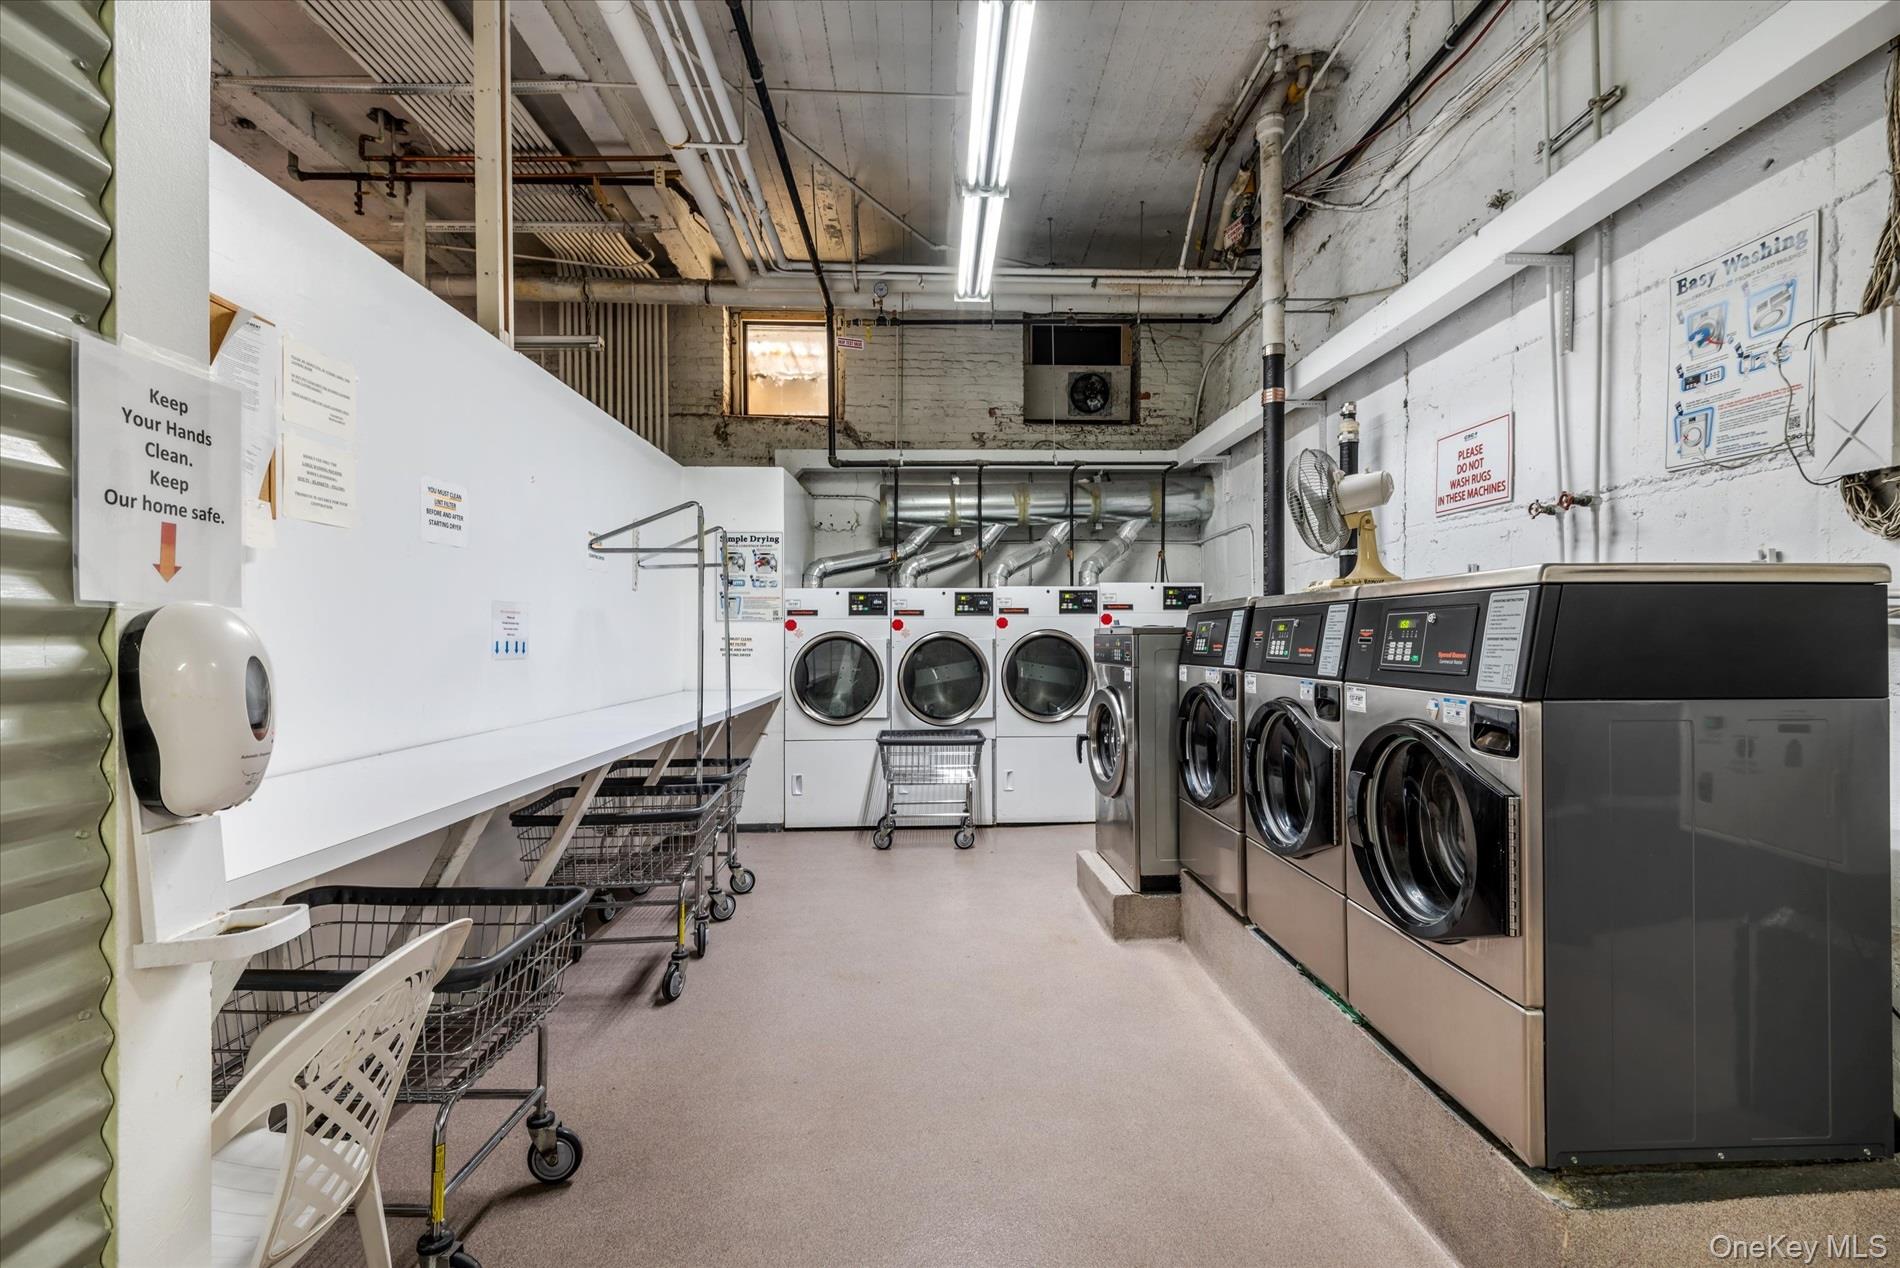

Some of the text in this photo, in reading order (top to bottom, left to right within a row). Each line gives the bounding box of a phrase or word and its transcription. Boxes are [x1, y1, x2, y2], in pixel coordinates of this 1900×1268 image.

[1676, 229, 1808, 296] Easy Washing
[149, 388, 189, 415] Keep
[121, 406, 212, 447] Your Hands
[145, 442, 193, 467] Clean.
[1457, 444, 1483, 461] PLEASE
[1456, 457, 1484, 475] DO NOT
[150, 470, 189, 493] Keep
[1449, 469, 1491, 490] WASH RUGS
[427, 486, 462, 500] YOU MUST CLEAN
[1437, 480, 1506, 506] IN THESE MACHINES
[104, 488, 225, 526] Our home safe.
[426, 508, 464, 521] BEFORE AND AFTER
[428, 519, 449, 528] STARTING
[720, 535, 780, 544] Smple Drying
